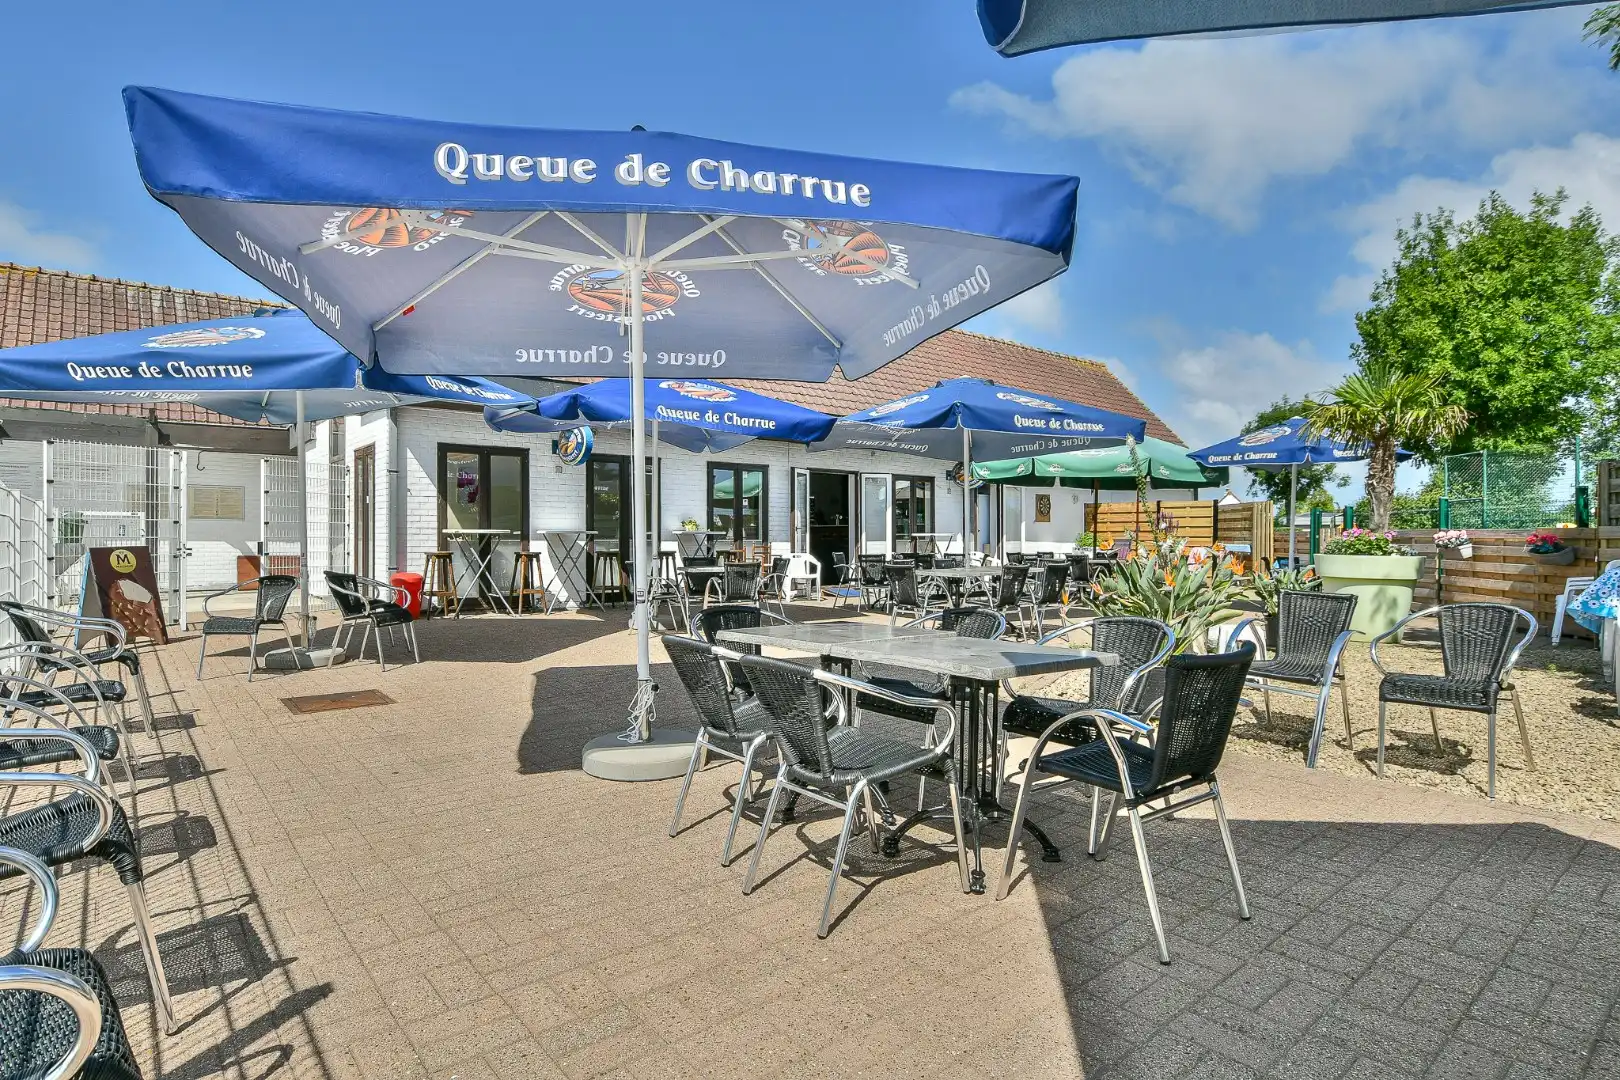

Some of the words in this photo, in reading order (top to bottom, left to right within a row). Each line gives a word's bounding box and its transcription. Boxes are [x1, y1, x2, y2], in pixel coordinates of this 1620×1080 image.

[434, 142, 597, 184] Queue
[615, 153, 670, 186] de
[687, 158, 872, 206] Charrue
[67, 361, 133, 381] Queue
[138, 361, 162, 378] de
[167, 360, 253, 378] Charrue
[657, 405, 700, 421] Queue
[705, 410, 720, 423] de
[724, 412, 776, 429] Charrue
[1014, 414, 1047, 428] Queue
[1049, 417, 1061, 430] de
[1063, 418, 1105, 431] Charrue
[1208, 455, 1231, 463] Queue
[1244, 451, 1277, 460] Charrue
[115, 554, 131, 565] M
